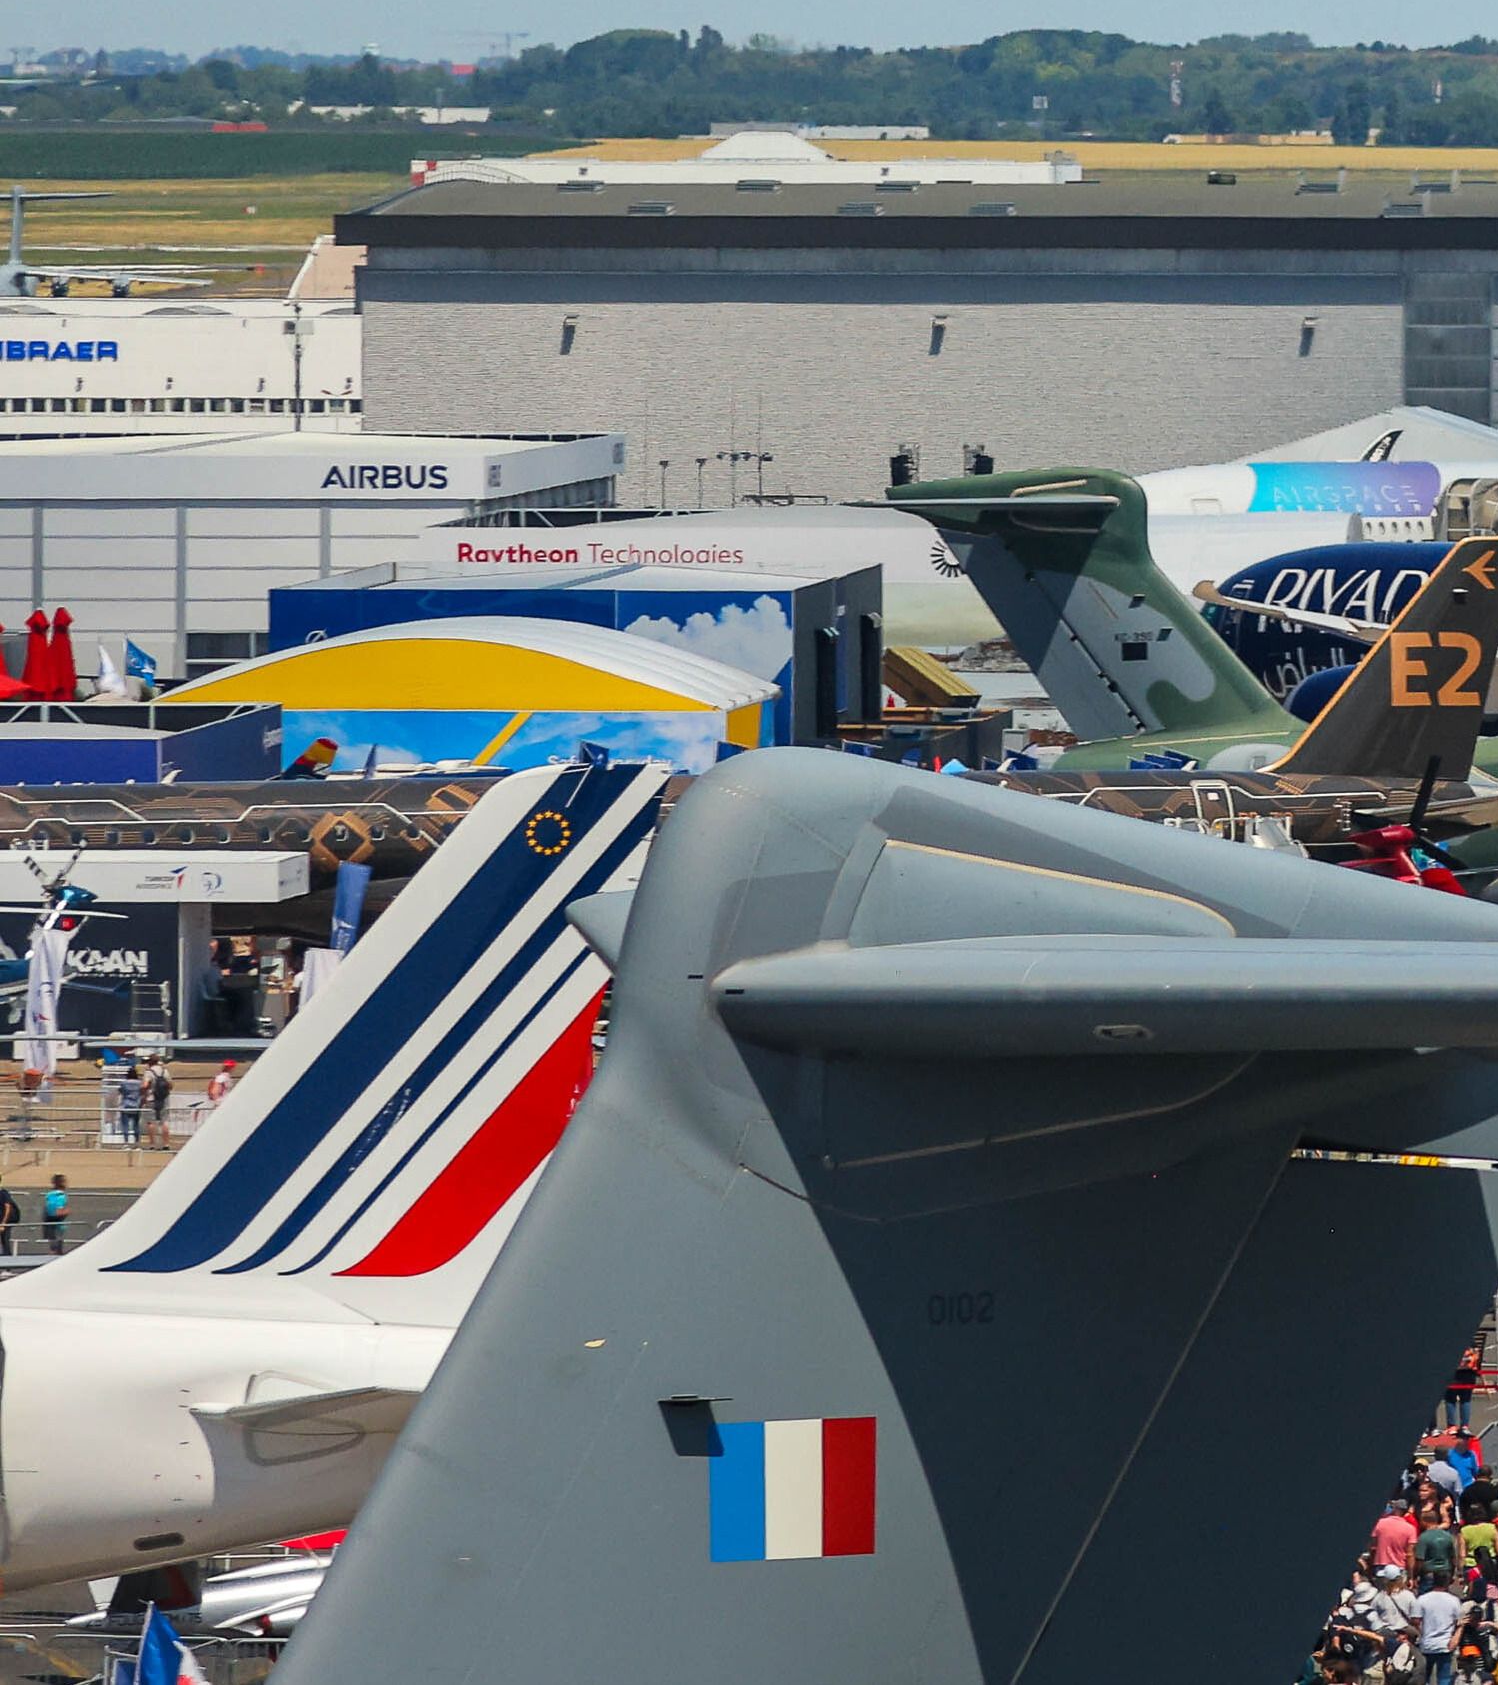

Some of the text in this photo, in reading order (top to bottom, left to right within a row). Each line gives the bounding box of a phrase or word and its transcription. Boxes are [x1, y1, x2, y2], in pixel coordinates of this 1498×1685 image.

[0, 341, 118, 362] BRAER
[320, 465, 449, 489] AIRBUS
[1257, 568, 1430, 634] RIYAD
[1390, 632, 1483, 707] E2
